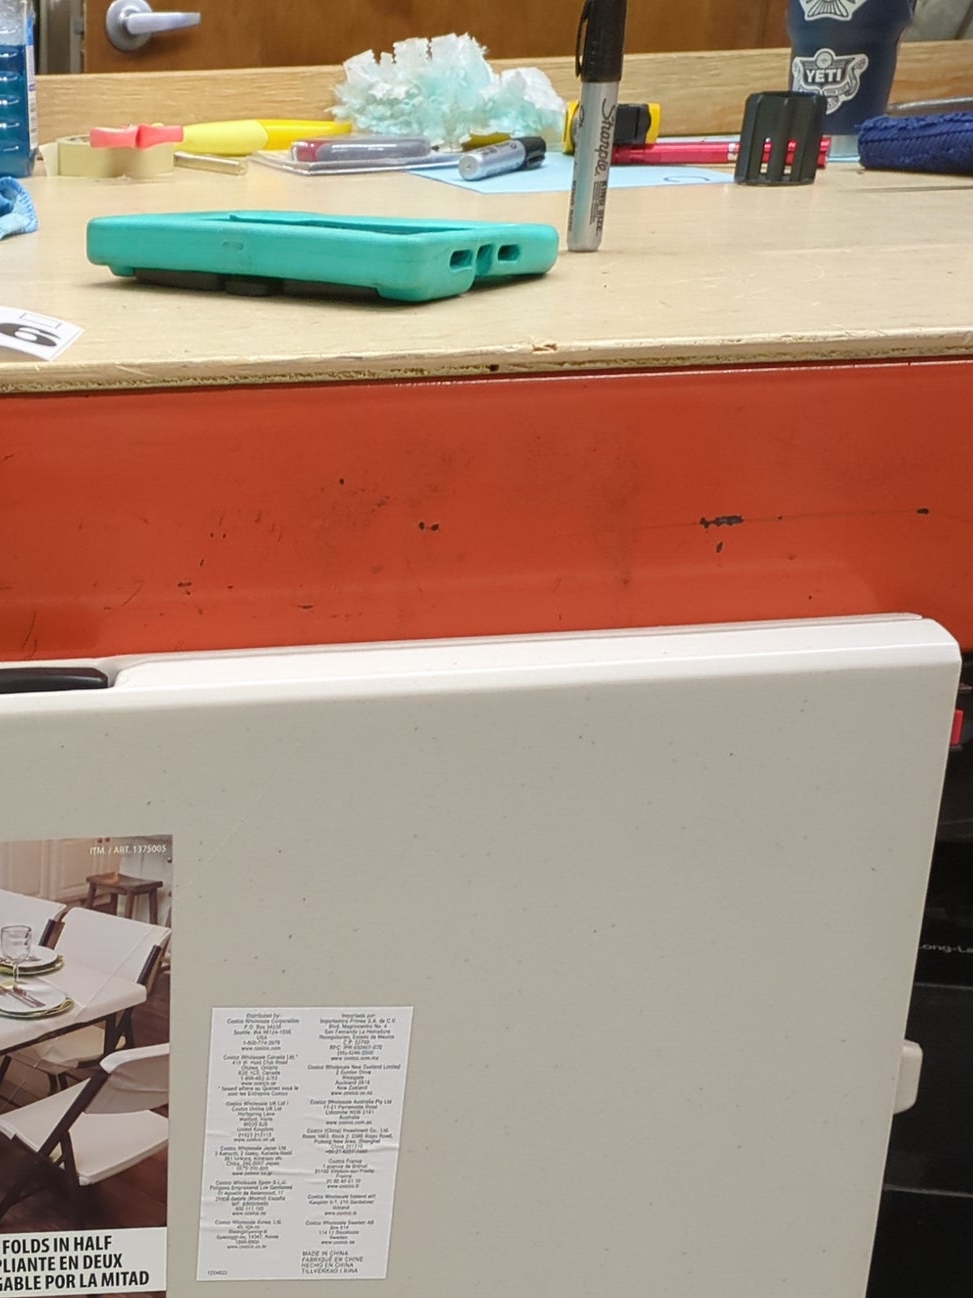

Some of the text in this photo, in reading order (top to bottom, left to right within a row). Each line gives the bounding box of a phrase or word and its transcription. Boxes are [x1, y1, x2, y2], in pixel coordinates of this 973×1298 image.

[806, 68, 842, 83] YETI
[90, 846, 105, 855] ITM
[2, 1235, 113, 1254] FOLDS IN HALF
[59, 1255, 78, 1271] EN
[82, 1253, 123, 1269] DEUX
[45, 1274, 75, 1290] POR
[79, 1272, 98, 1288] LA
[100, 1270, 150, 1287] MITAD
